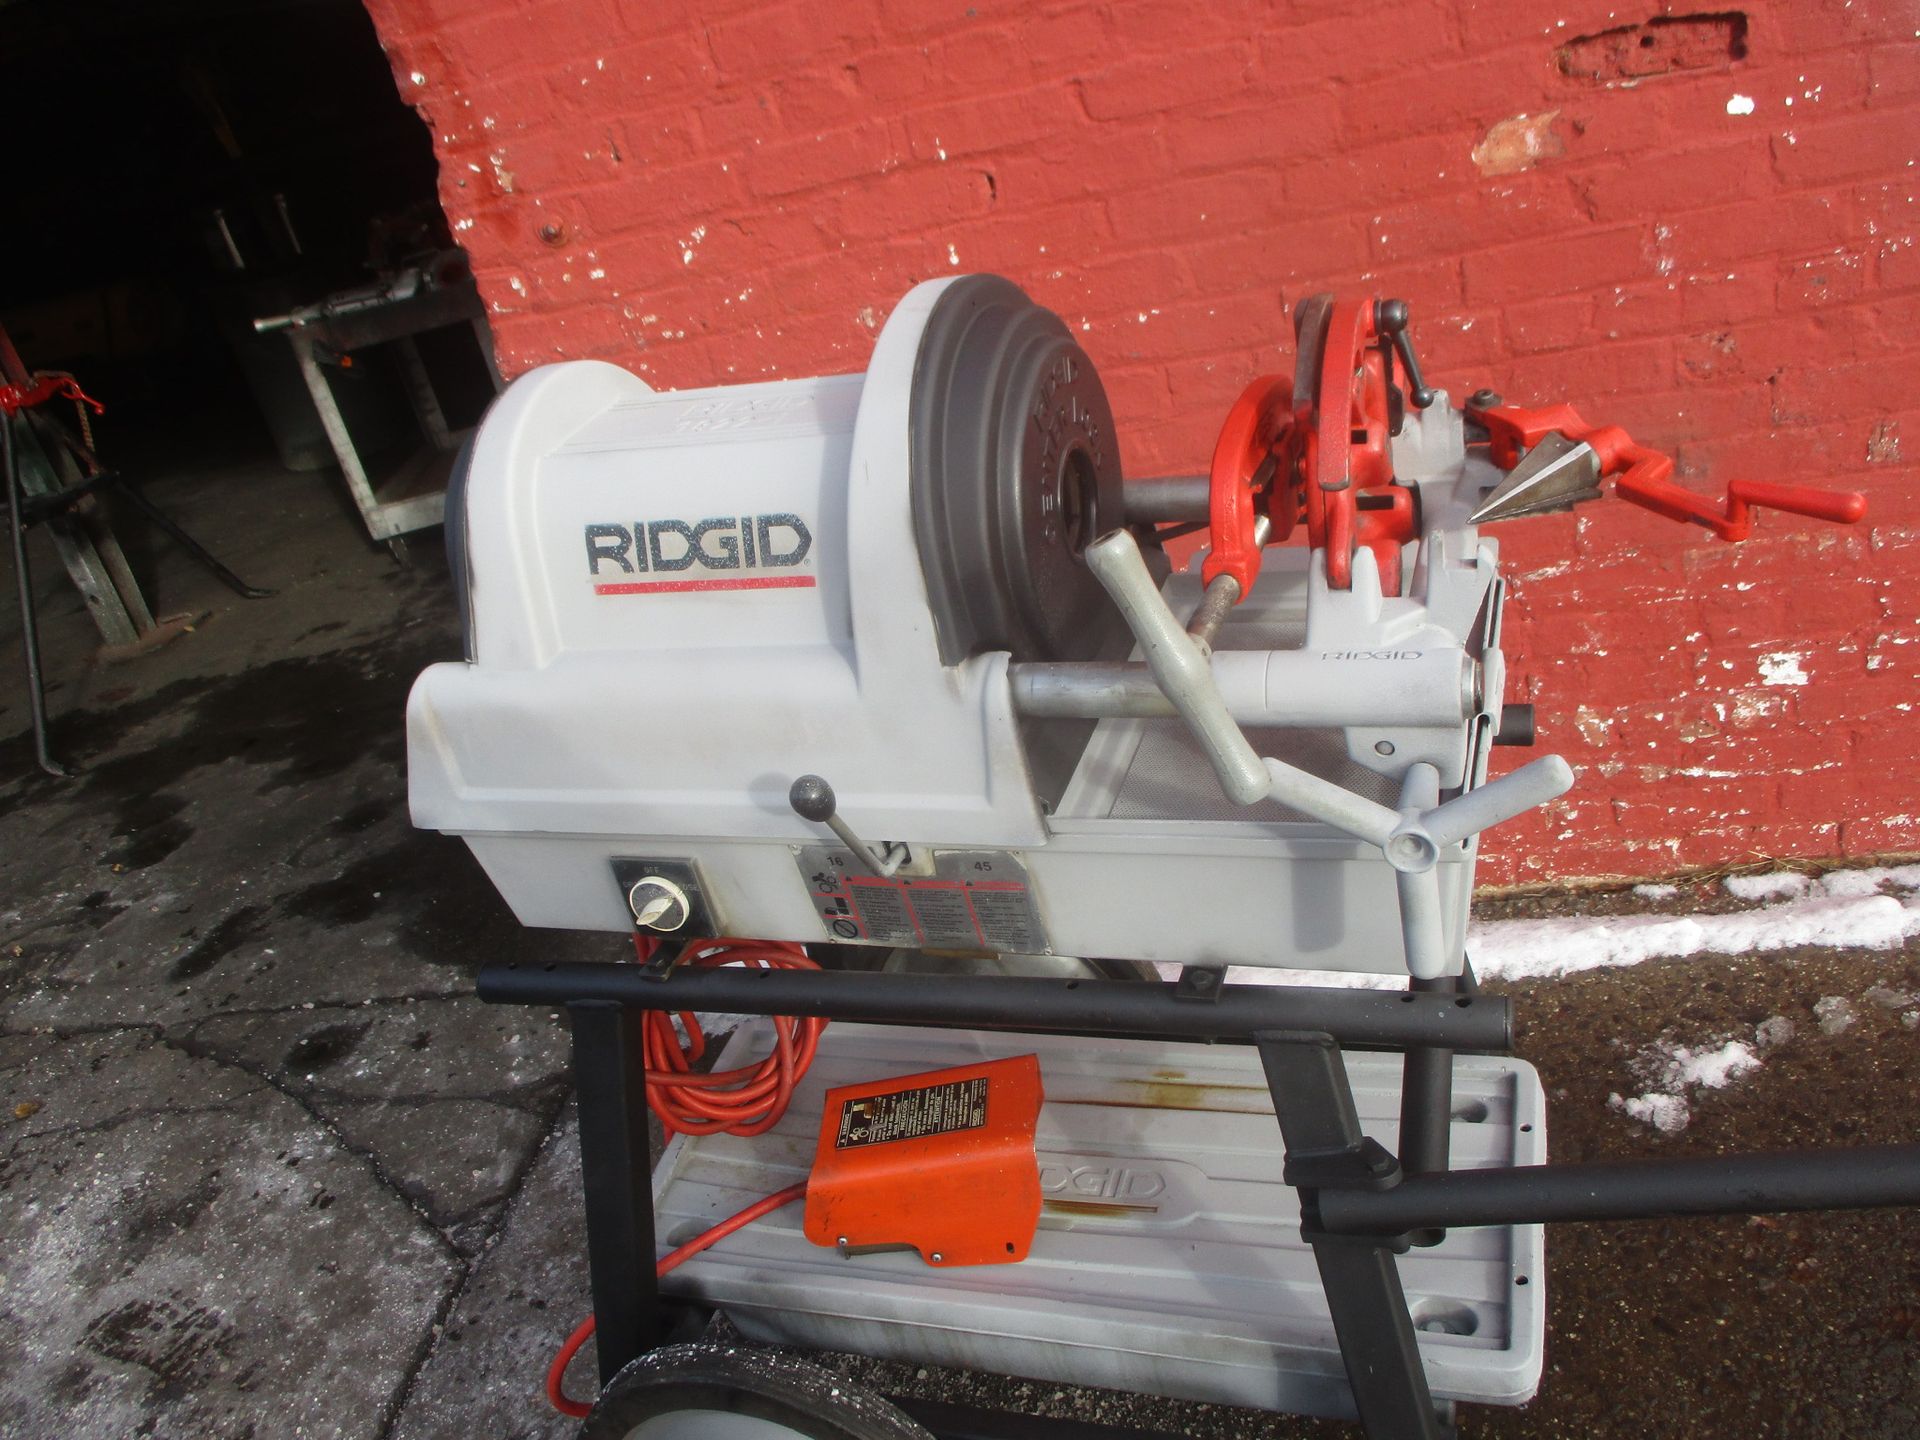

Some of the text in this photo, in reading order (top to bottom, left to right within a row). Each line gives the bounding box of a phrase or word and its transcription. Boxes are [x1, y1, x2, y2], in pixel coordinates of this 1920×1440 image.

[585, 513, 812, 575] RIDGID
[1321, 650, 1423, 661] RIDGID
[827, 856, 844, 867] 16
[975, 861, 992, 872] 45
